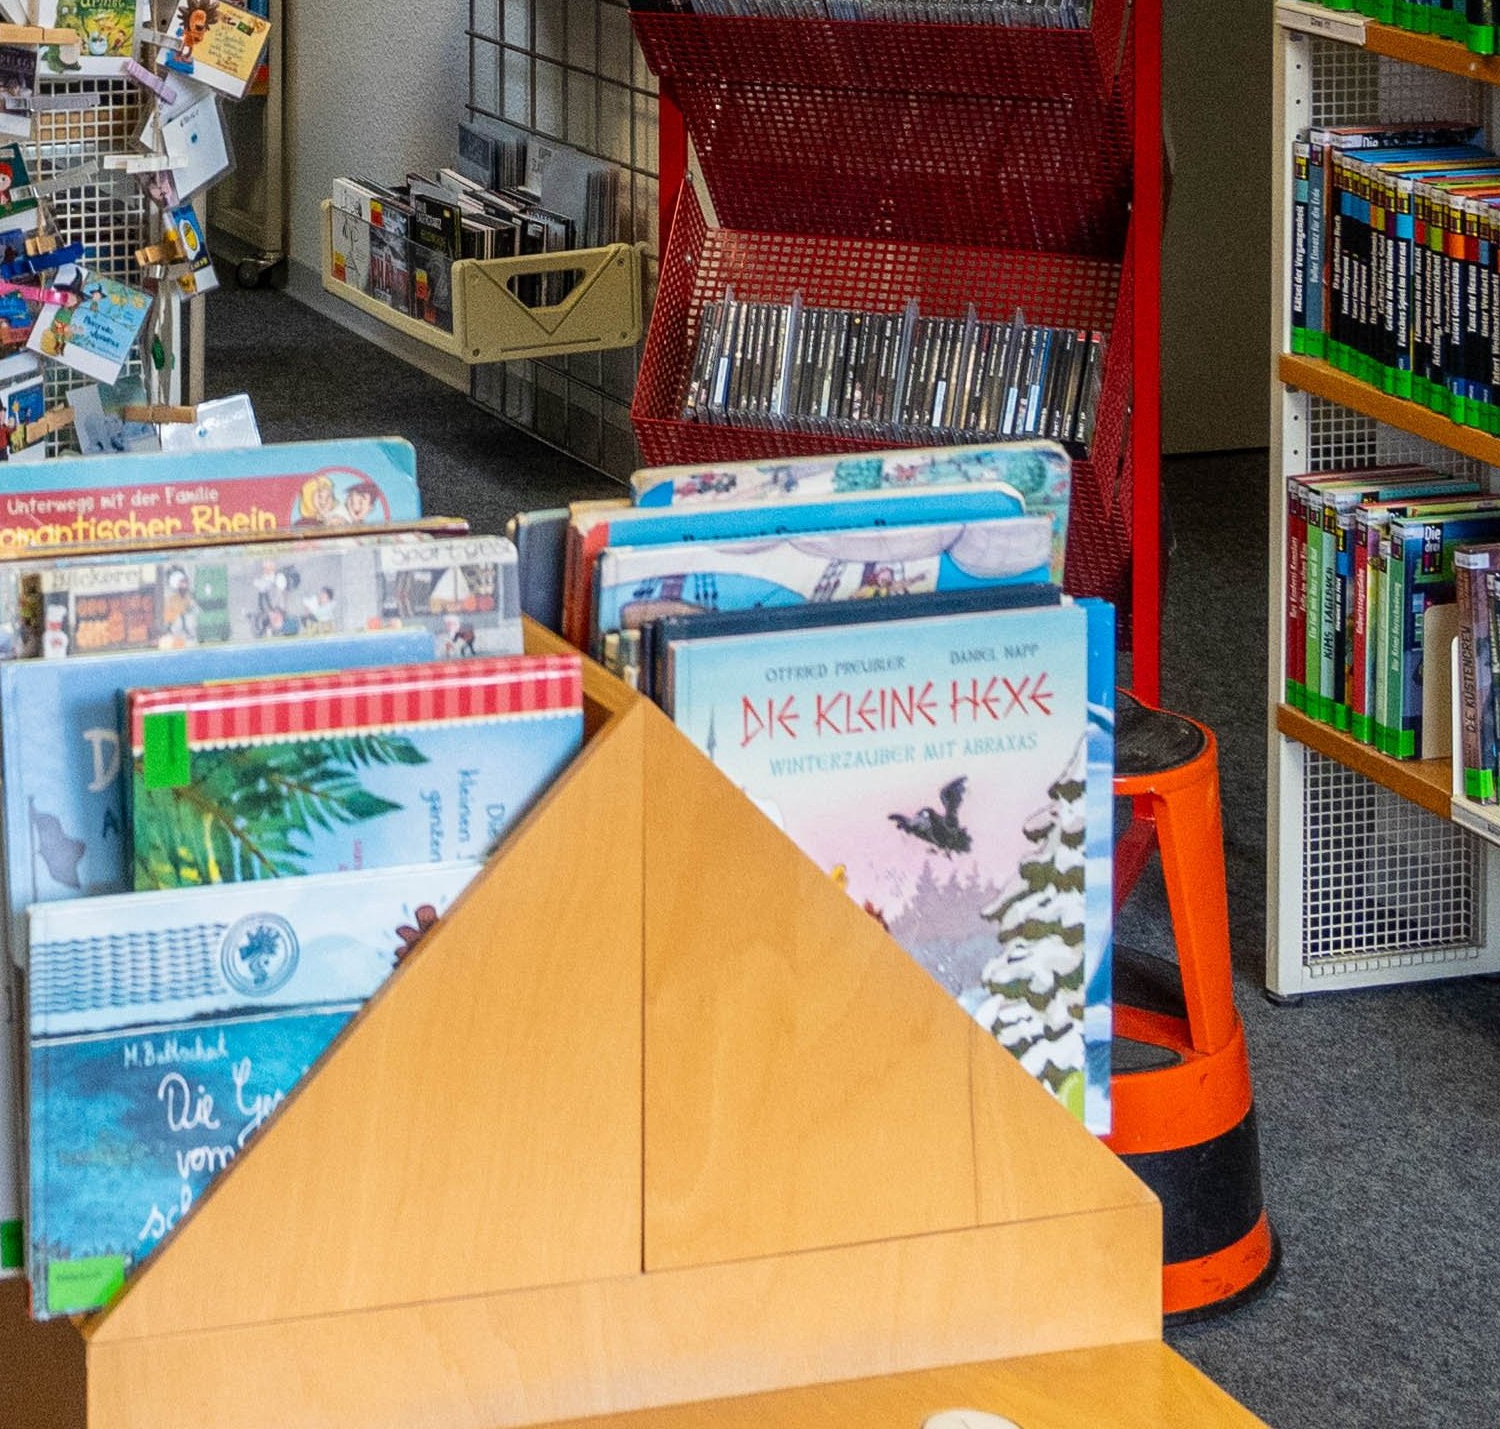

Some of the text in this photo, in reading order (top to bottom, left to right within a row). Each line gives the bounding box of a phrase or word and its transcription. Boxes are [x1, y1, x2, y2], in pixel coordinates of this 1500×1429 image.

[6, 485, 219, 517] Unterwegs mit der Familie
[195, 504, 279, 537] Rhein
[765, 662, 828, 682] OTFRIED
[950, 647, 996, 665] DANIEL
[1004, 642, 1039, 659] NAPP
[740, 673, 1054, 748] DIE KLEINE HEXE
[769, 731, 1038, 776] WINTERZAUBER MIT ABRAXAS
